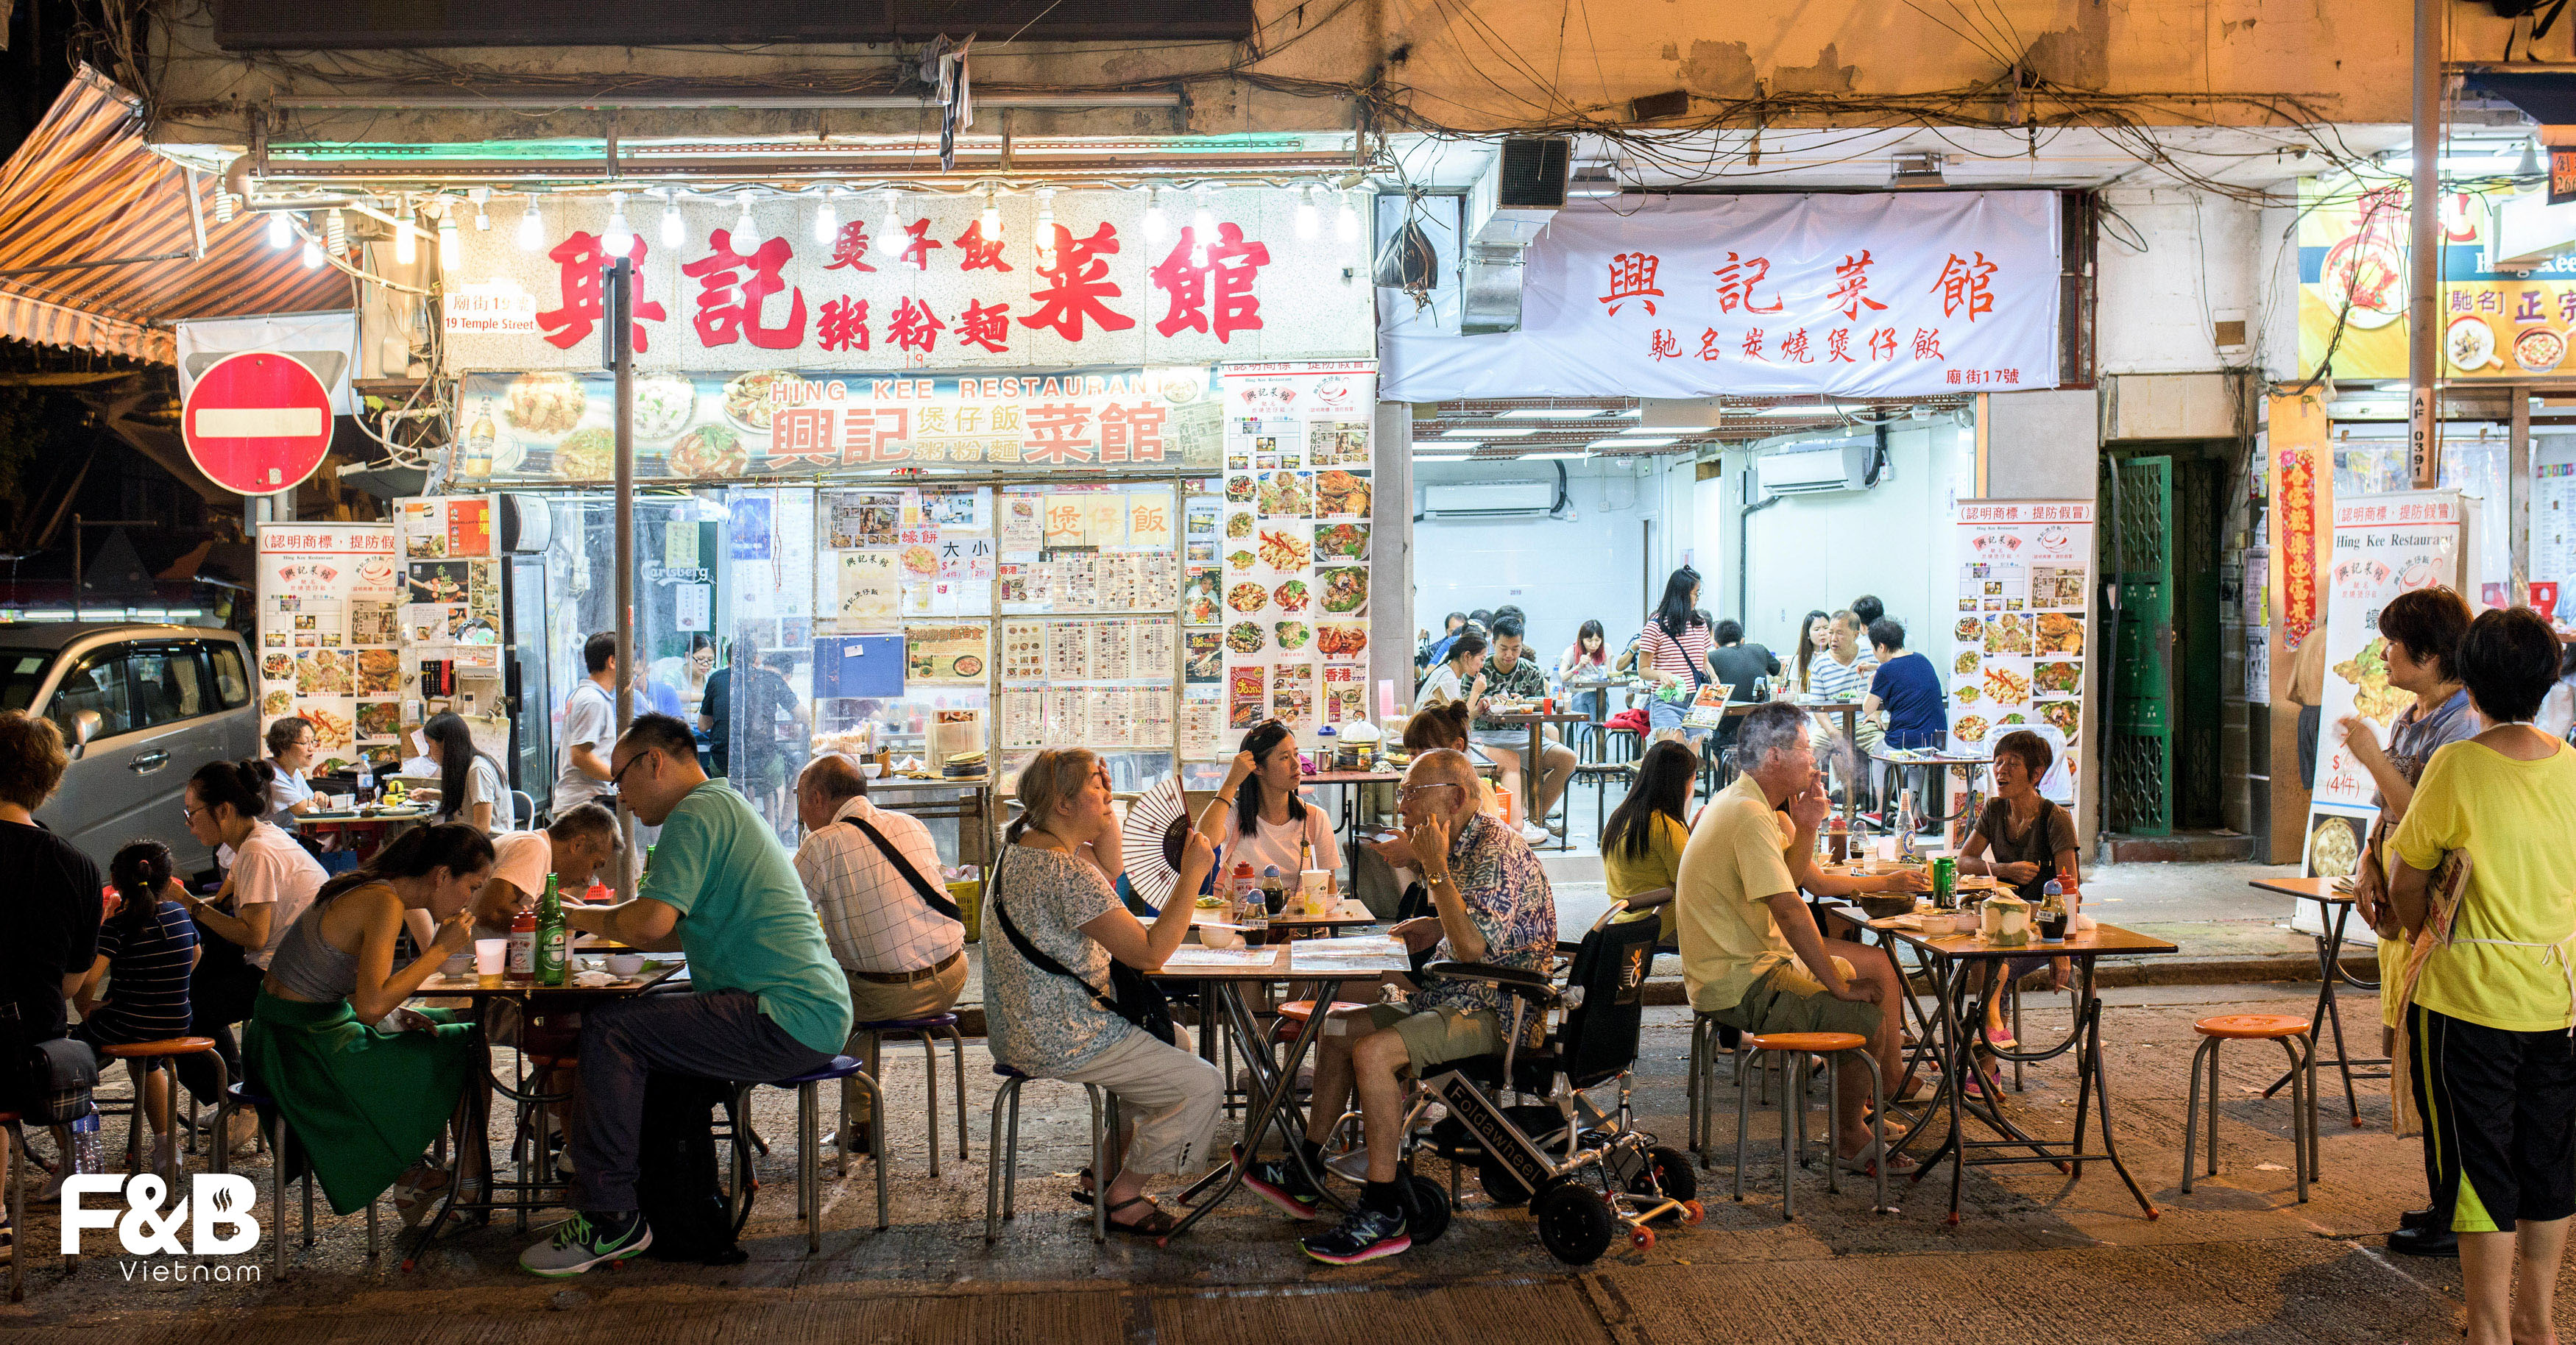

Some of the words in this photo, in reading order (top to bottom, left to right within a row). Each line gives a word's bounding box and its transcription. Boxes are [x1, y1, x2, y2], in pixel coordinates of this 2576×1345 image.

[2556, 155, 2576, 173] 創
[823, 218, 1013, 273] 煲仔飯
[535, 228, 807, 353] 興記
[1016, 221, 1270, 344] 菜館
[1598, 249, 1999, 322] 興記菜館
[445, 317, 457, 328] 19
[461, 317, 498, 331] Temple
[502, 318, 534, 330] Street
[815, 294, 1011, 353] 粥粉麵
[1647, 327, 1945, 363] 馳名炭燒煲仔飯
[906, 353, 923, 369] 19
[1946, 368, 2020, 385] 廟街17號
[771, 380, 847, 403] HING
[874, 378, 935, 400] KEE
[917, 405, 1020, 433] 煲仔飯
[765, 406, 913, 469] 興記
[1024, 401, 1169, 464] 菜館
[914, 440, 1020, 462] 粥粉麵
[2414, 430, 2424, 477] 0391
[1044, 503, 1167, 539] 煲仔飯
[902, 530, 938, 544] 蠔餅
[943, 541, 959, 558] 大
[972, 540, 988, 557] 小
[2336, 534, 2360, 550] Hing
[2367, 534, 2385, 547] Kee
[2391, 533, 2454, 547] Restaurant
[641, 559, 710, 582] Carlsberg
[845, 553, 889, 569] 興記菜館
[999, 566, 1017, 575] 香港
[1325, 668, 1351, 682] 香港
[2326, 774, 2360, 799] (4件)
[1448, 1084, 1540, 1182] Foldawheel
